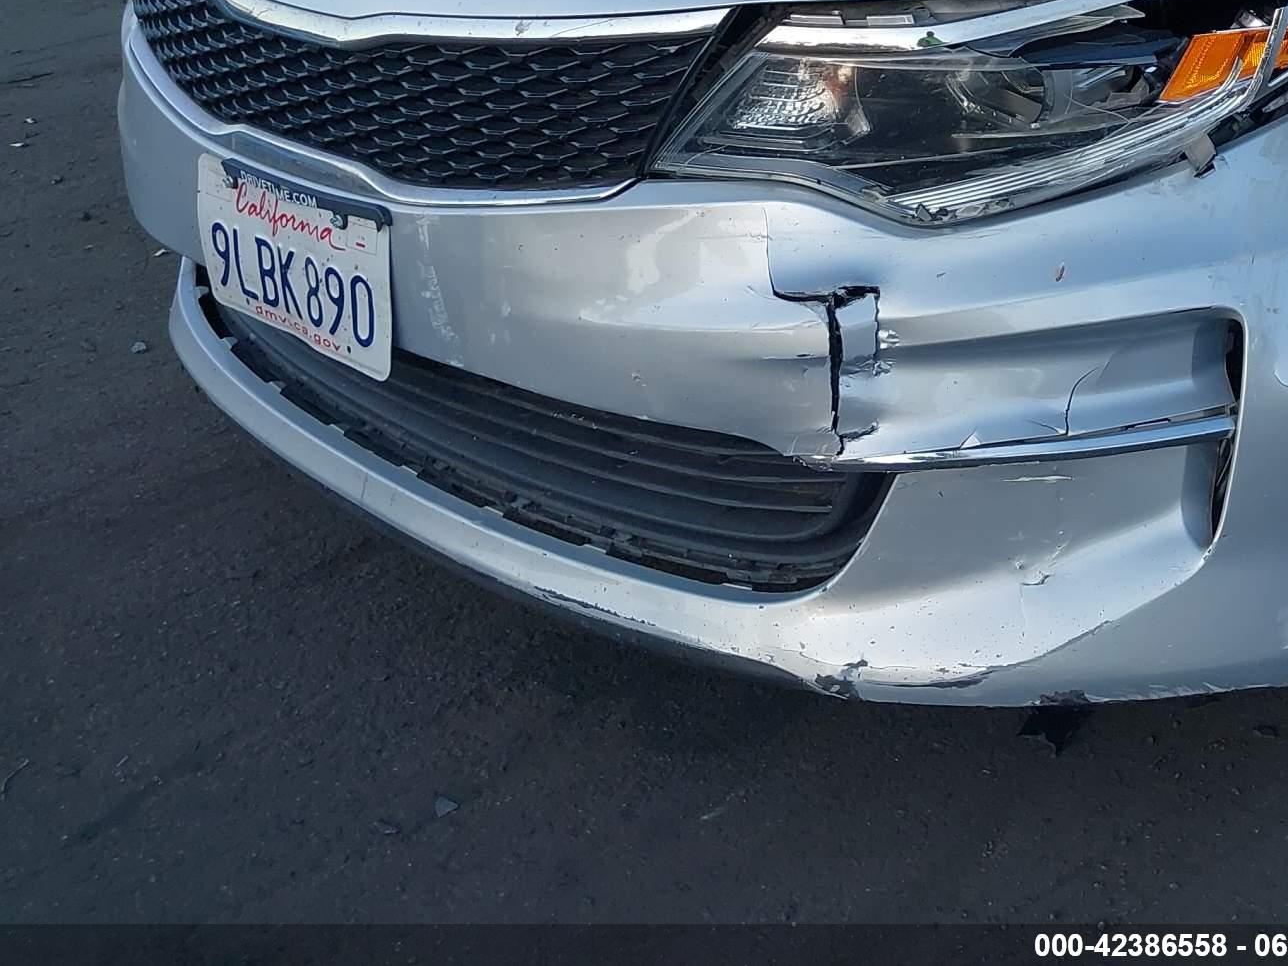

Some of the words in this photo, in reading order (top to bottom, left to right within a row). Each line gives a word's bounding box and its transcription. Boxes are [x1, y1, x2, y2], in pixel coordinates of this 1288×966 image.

[236, 182, 346, 252] California
[239, 170, 317, 208] DRIVETIME.COM
[211, 221, 375, 349] 9LBK890
[255, 305, 341, 351] dmv.ca.gov
